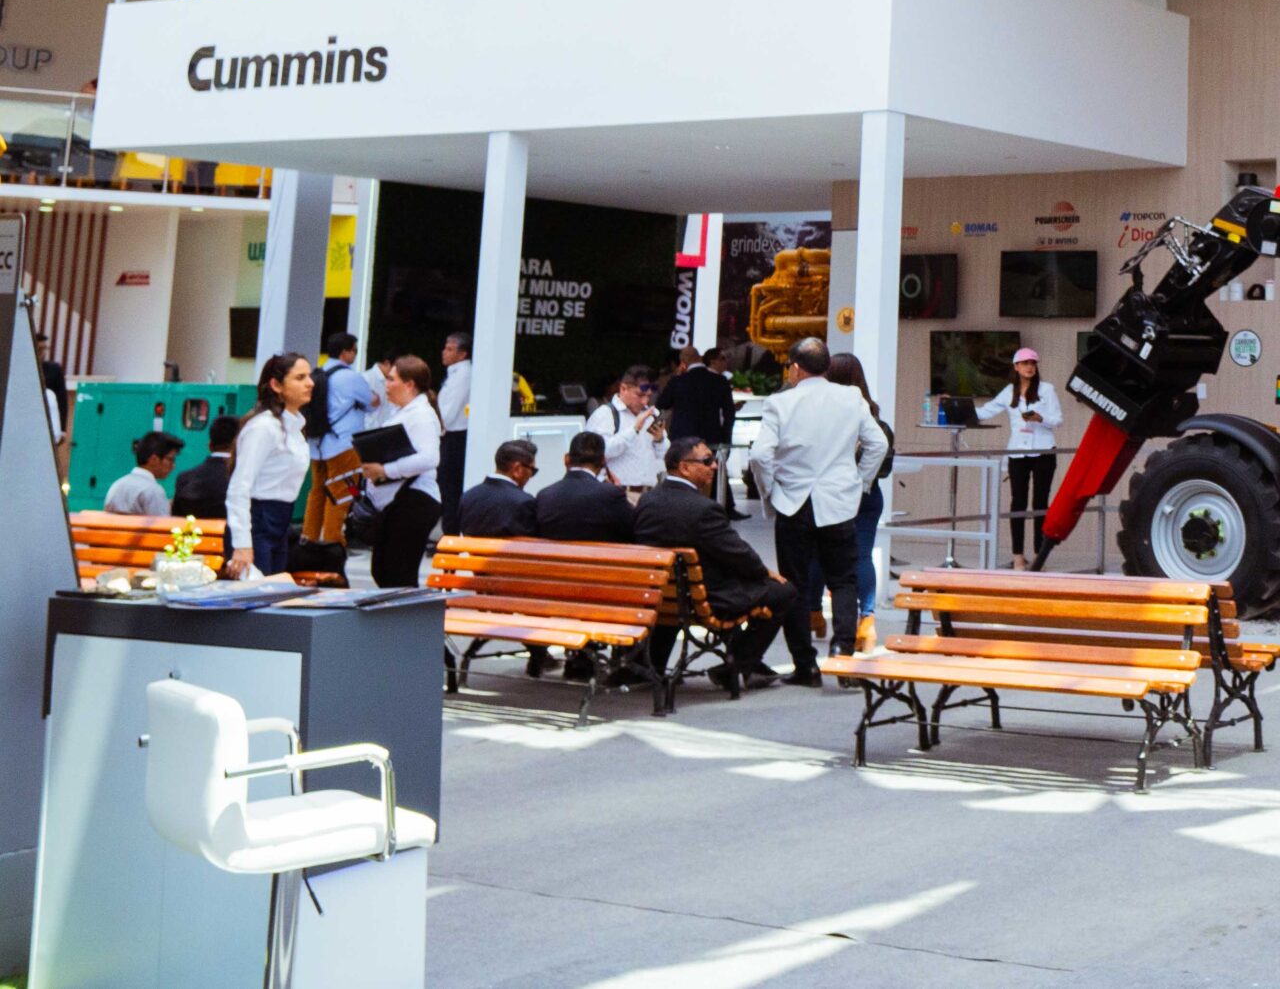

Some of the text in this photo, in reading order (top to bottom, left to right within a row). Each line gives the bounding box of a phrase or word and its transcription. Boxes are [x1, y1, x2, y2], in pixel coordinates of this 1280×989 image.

[187, 35, 389, 92] Cummins
[964, 222, 998, 233] BOMAG
[731, 236, 775, 257] grindex
[529, 278, 592, 299] MUNDO
[534, 299, 559, 317] NO
[562, 300, 586, 318] SE
[670, 271, 693, 350] wong
[1079, 382, 1128, 422] MANITOU
